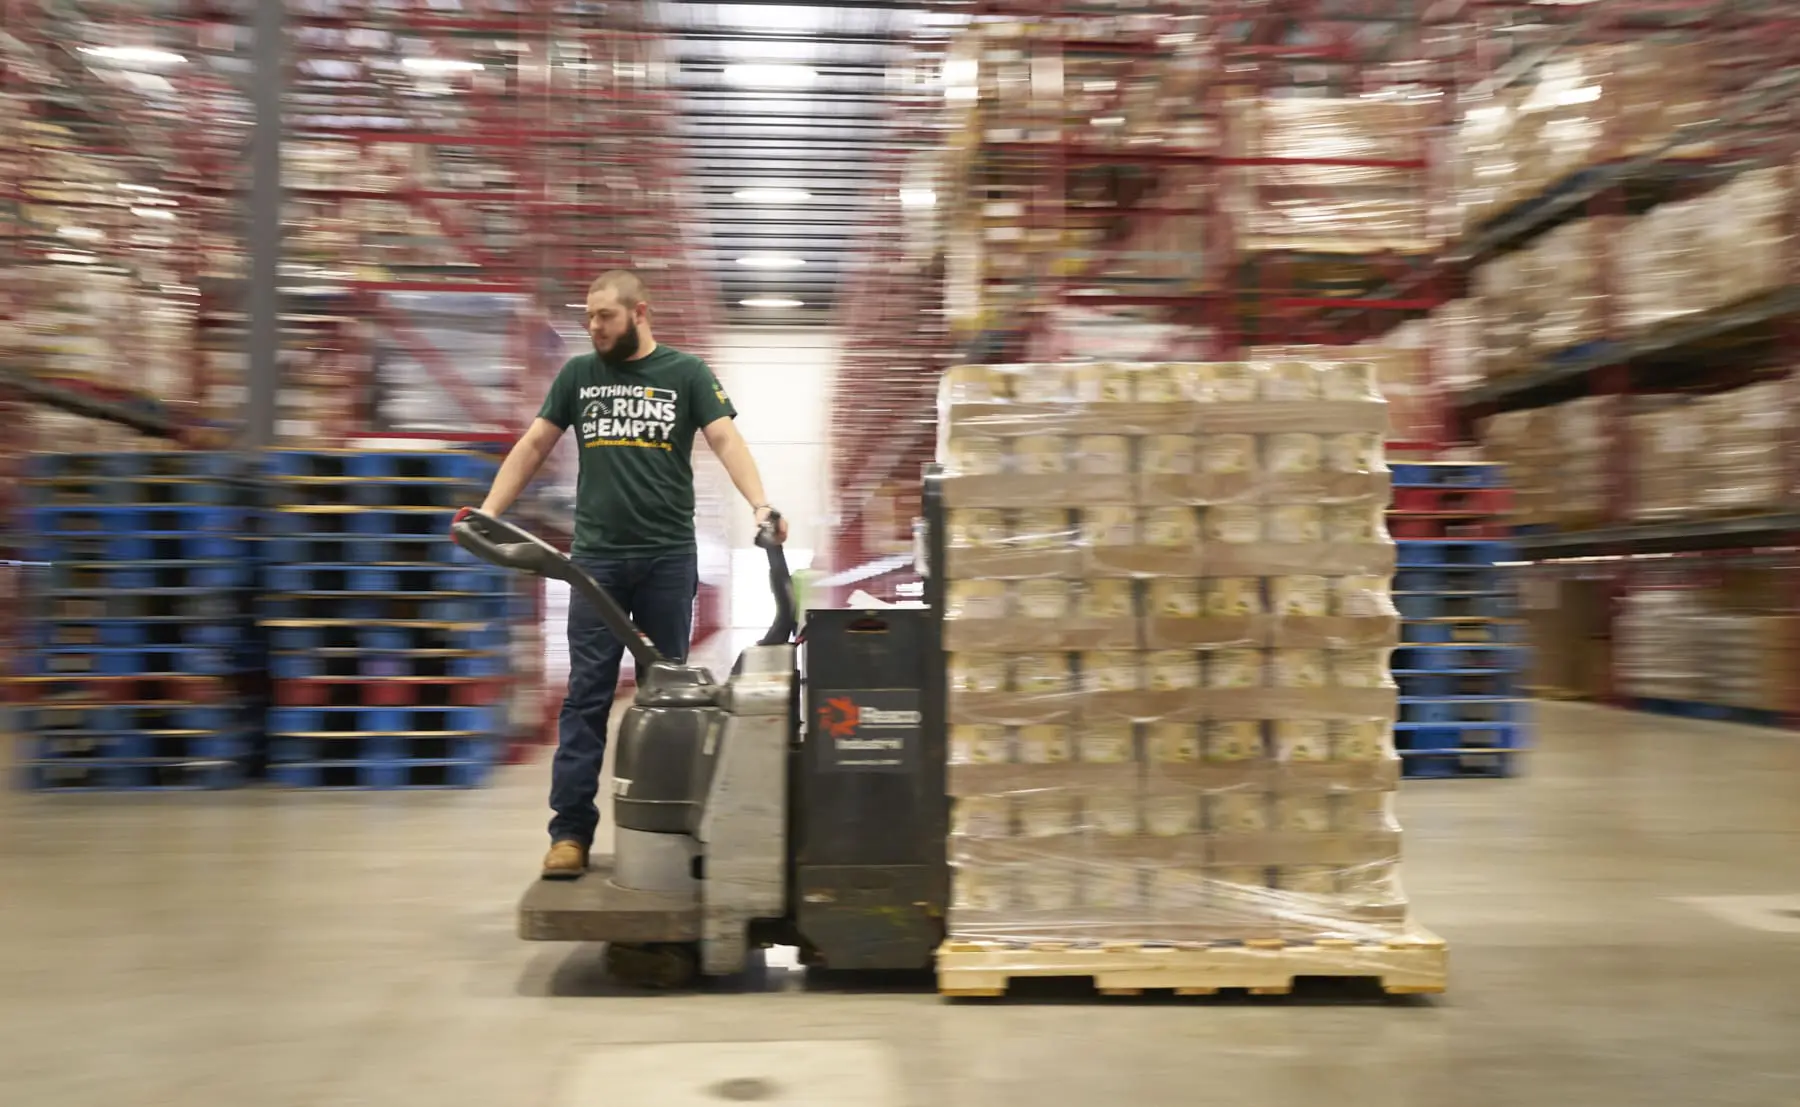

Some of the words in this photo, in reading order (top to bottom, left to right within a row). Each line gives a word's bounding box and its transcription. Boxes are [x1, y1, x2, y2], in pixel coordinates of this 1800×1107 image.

[580, 384, 644, 399] NOTHING
[612, 398, 676, 422] RUNS
[582, 421, 597, 434] ON
[598, 418, 675, 440] EMPTY
